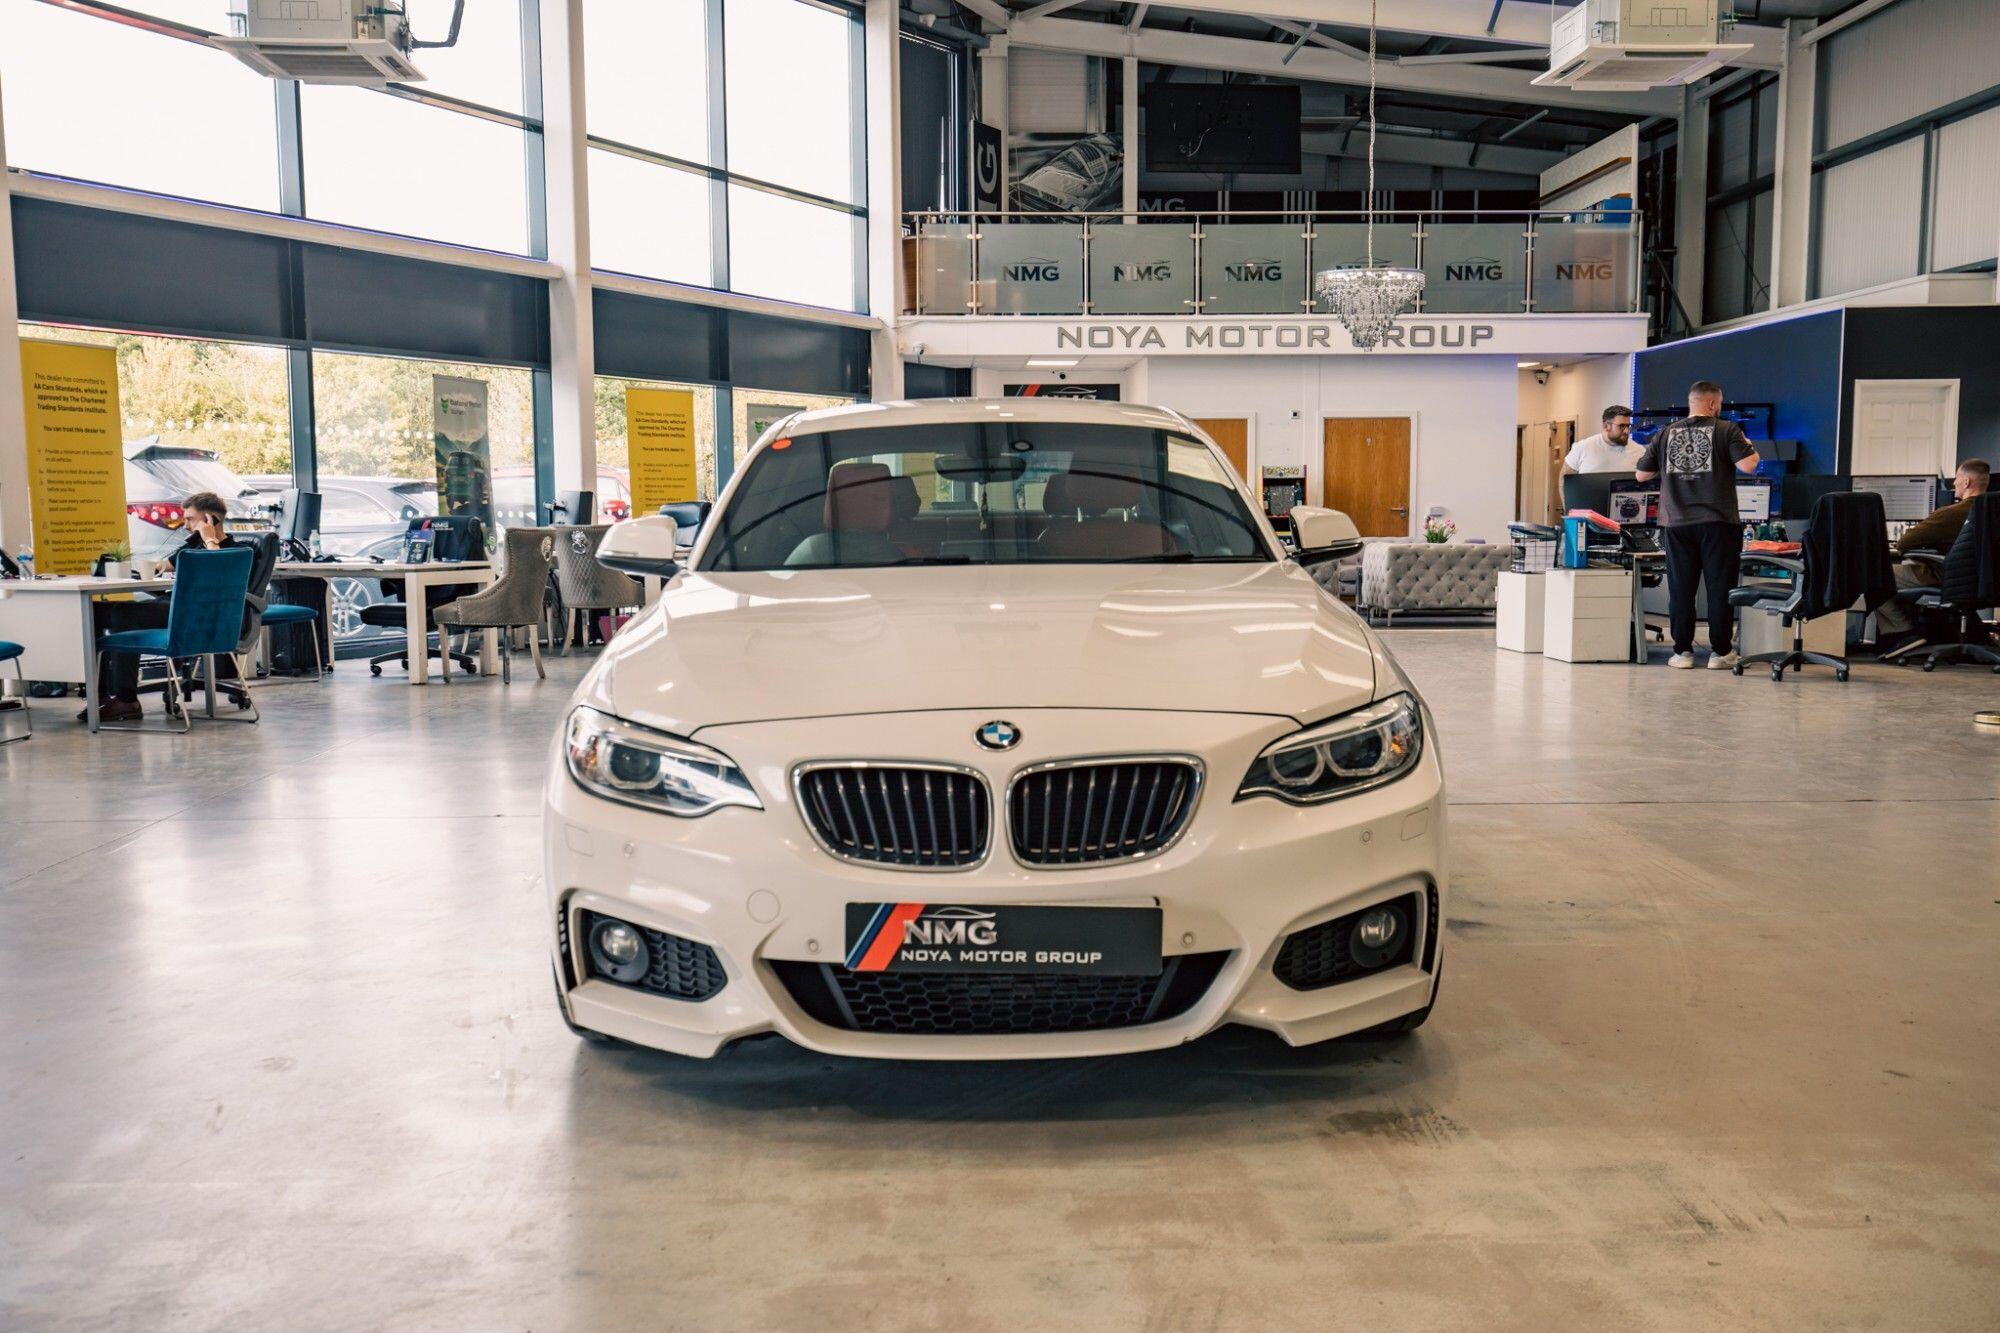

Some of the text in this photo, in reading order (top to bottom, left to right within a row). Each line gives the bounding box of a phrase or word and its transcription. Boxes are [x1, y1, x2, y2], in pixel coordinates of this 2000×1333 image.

[1002, 264, 1060, 282] NMG
[1224, 264, 1282, 282] NMG
[1446, 264, 1503, 282] NMG
[1556, 264, 1614, 282] NMG
[1057, 325, 1494, 348] NOYA MOTOR ROUP
[56, 385, 84, 393] Standards,
[37, 403, 56, 412] Trading
[902, 919, 997, 945] NMG
[901, 949, 1103, 965] NOYA MOTOR GROUP
